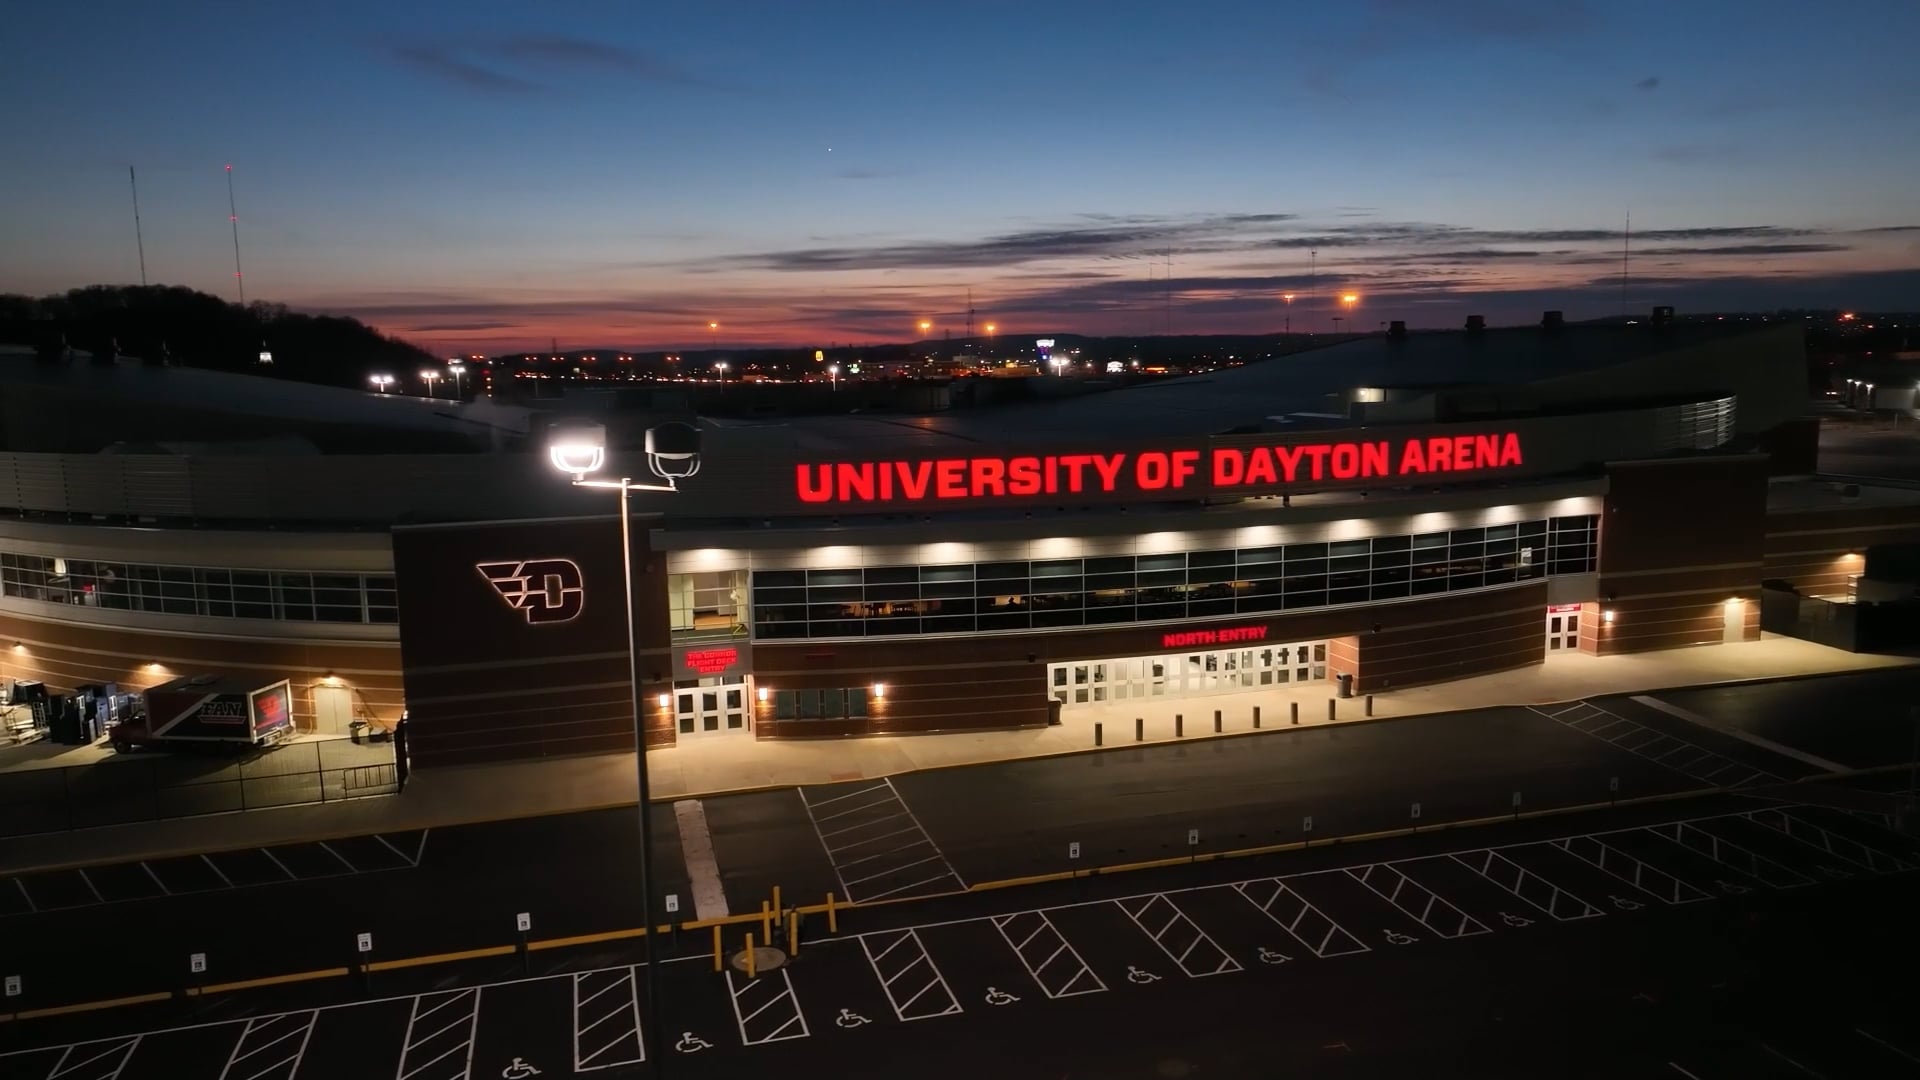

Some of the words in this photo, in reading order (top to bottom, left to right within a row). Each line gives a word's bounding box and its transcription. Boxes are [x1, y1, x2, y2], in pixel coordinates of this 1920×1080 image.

[796, 454, 1124, 502] UNIVERSITY
[1136, 451, 1198, 489] OF
[1213, 442, 1388, 486] DAYTON
[1399, 433, 1521, 474] ARENA
[1164, 632, 1216, 646] NORTH
[1218, 626, 1266, 641] ENTRY
[687, 659, 715, 667] FLIGHT
[700, 665, 726, 673] ENTRY
